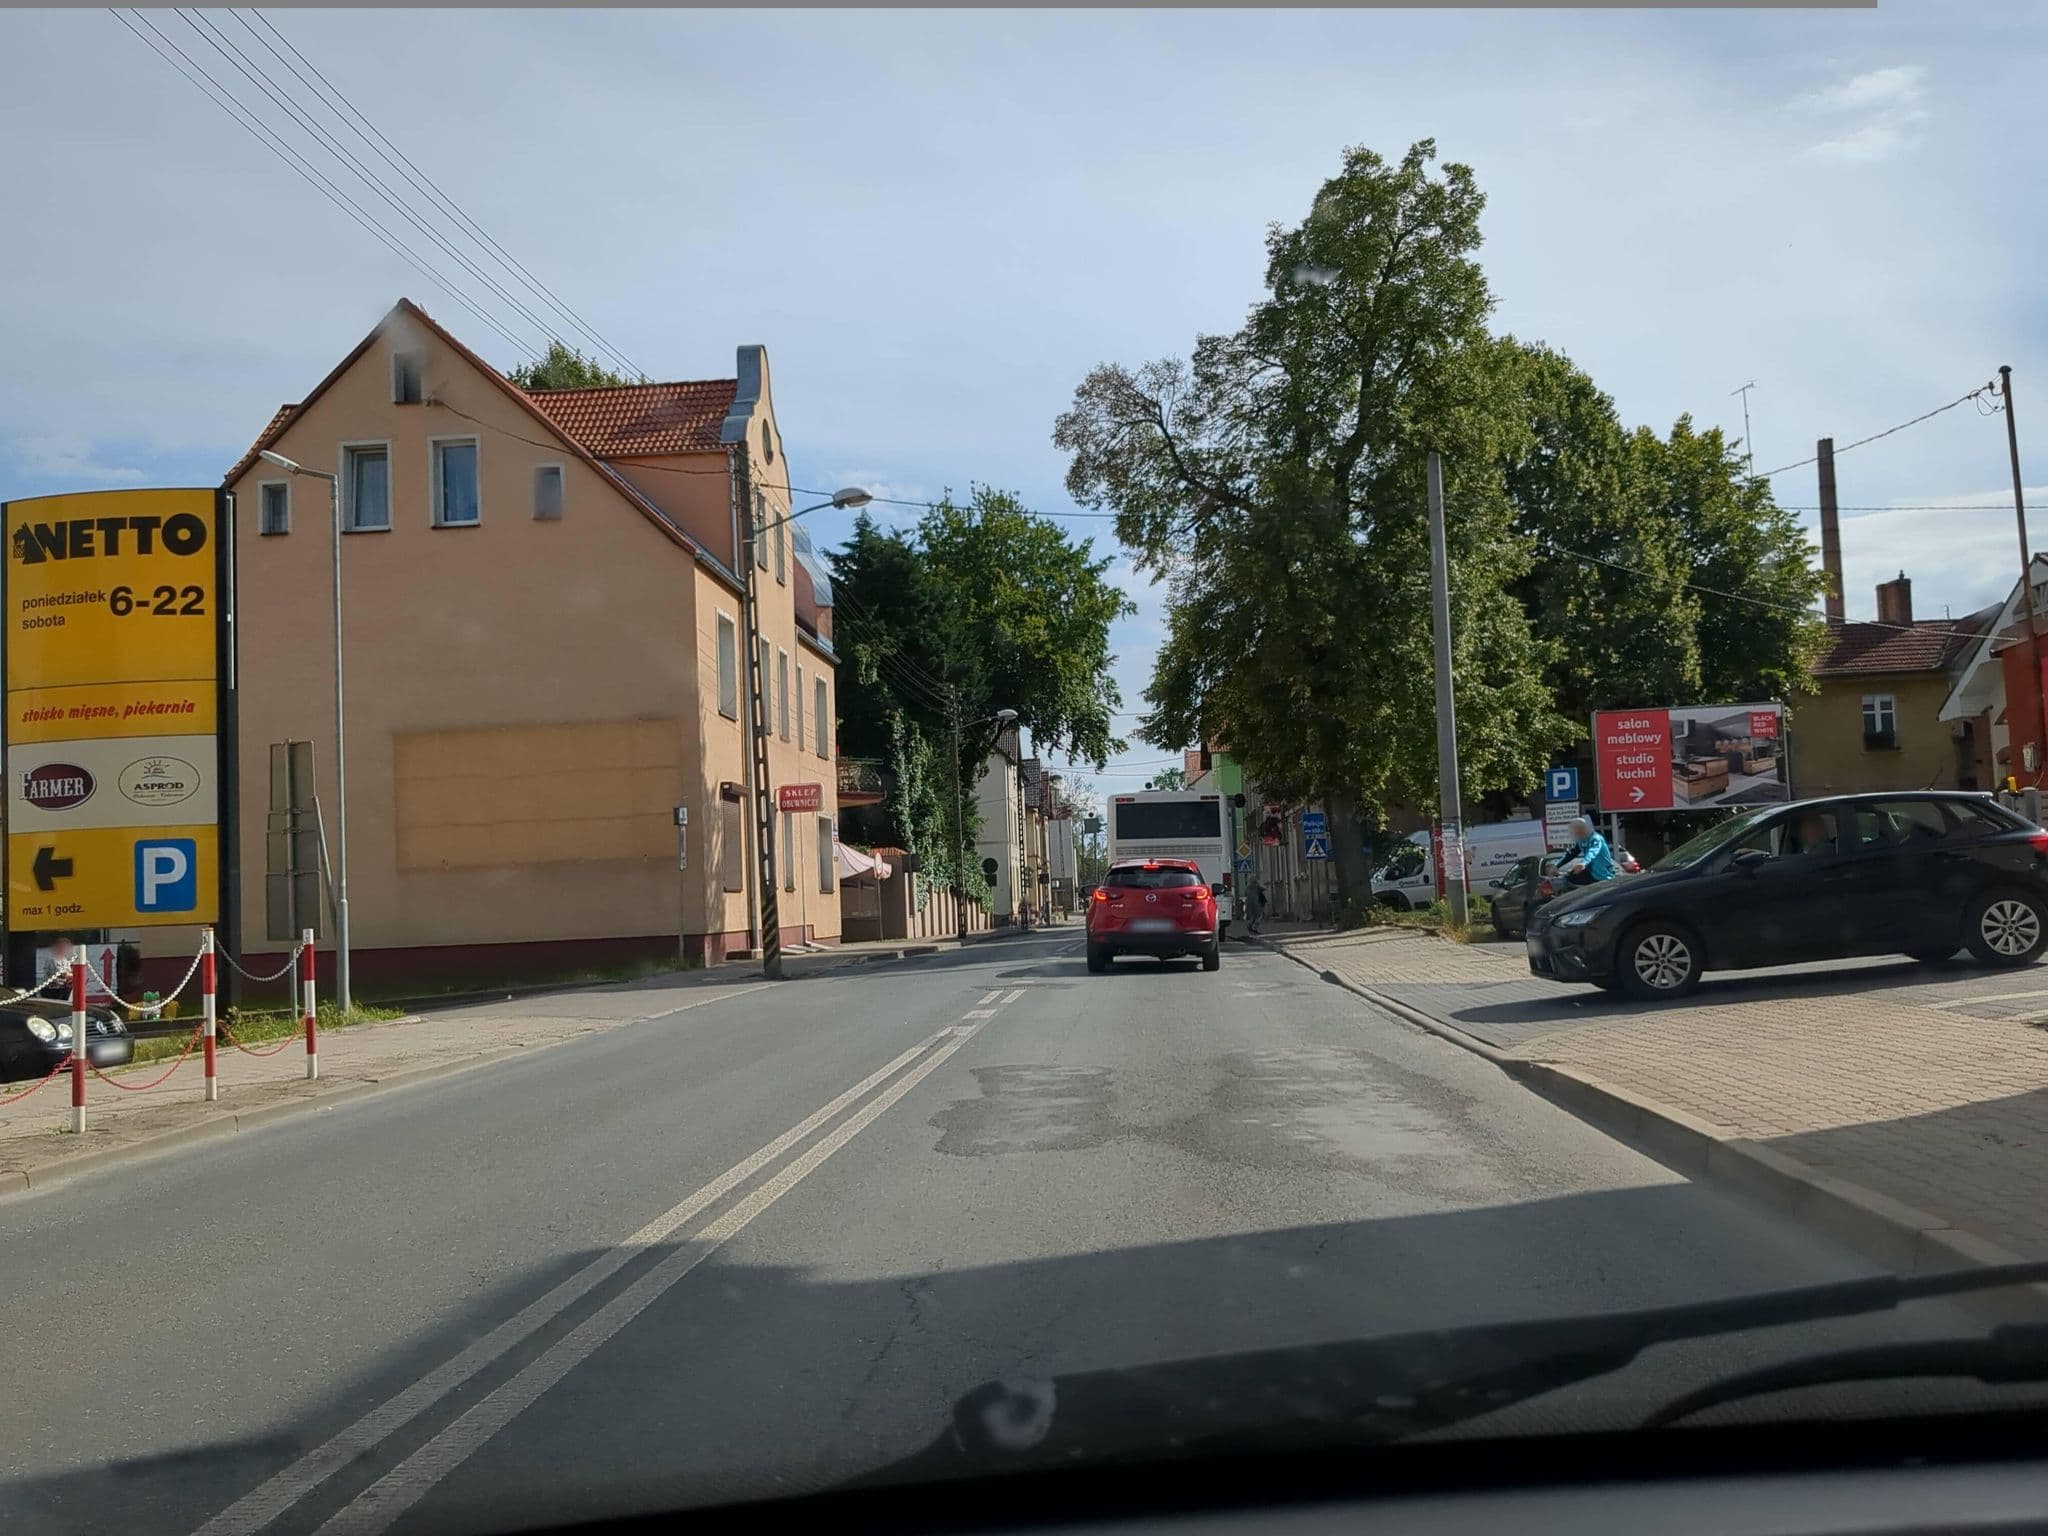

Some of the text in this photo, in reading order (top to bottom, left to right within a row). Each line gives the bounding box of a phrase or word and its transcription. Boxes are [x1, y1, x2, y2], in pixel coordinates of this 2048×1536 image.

[34, 513, 207, 558] NETTO
[22, 585, 205, 617] poniedziałek 6-22
[22, 614, 65, 629] sobota
[22, 700, 195, 723] stoisko mięsne, piekarnia
[1617, 718, 1650, 730] salon
[1607, 732, 1661, 746] meblowy
[1616, 753, 1654, 765] studio
[1616, 767, 1656, 780] kuchni
[134, 782, 185, 791] ASPROD
[1552, 772, 1571, 797] P
[785, 789, 817, 797] SKLEP
[143, 847, 188, 905] P
[22, 903, 85, 916] max 1 godz.
